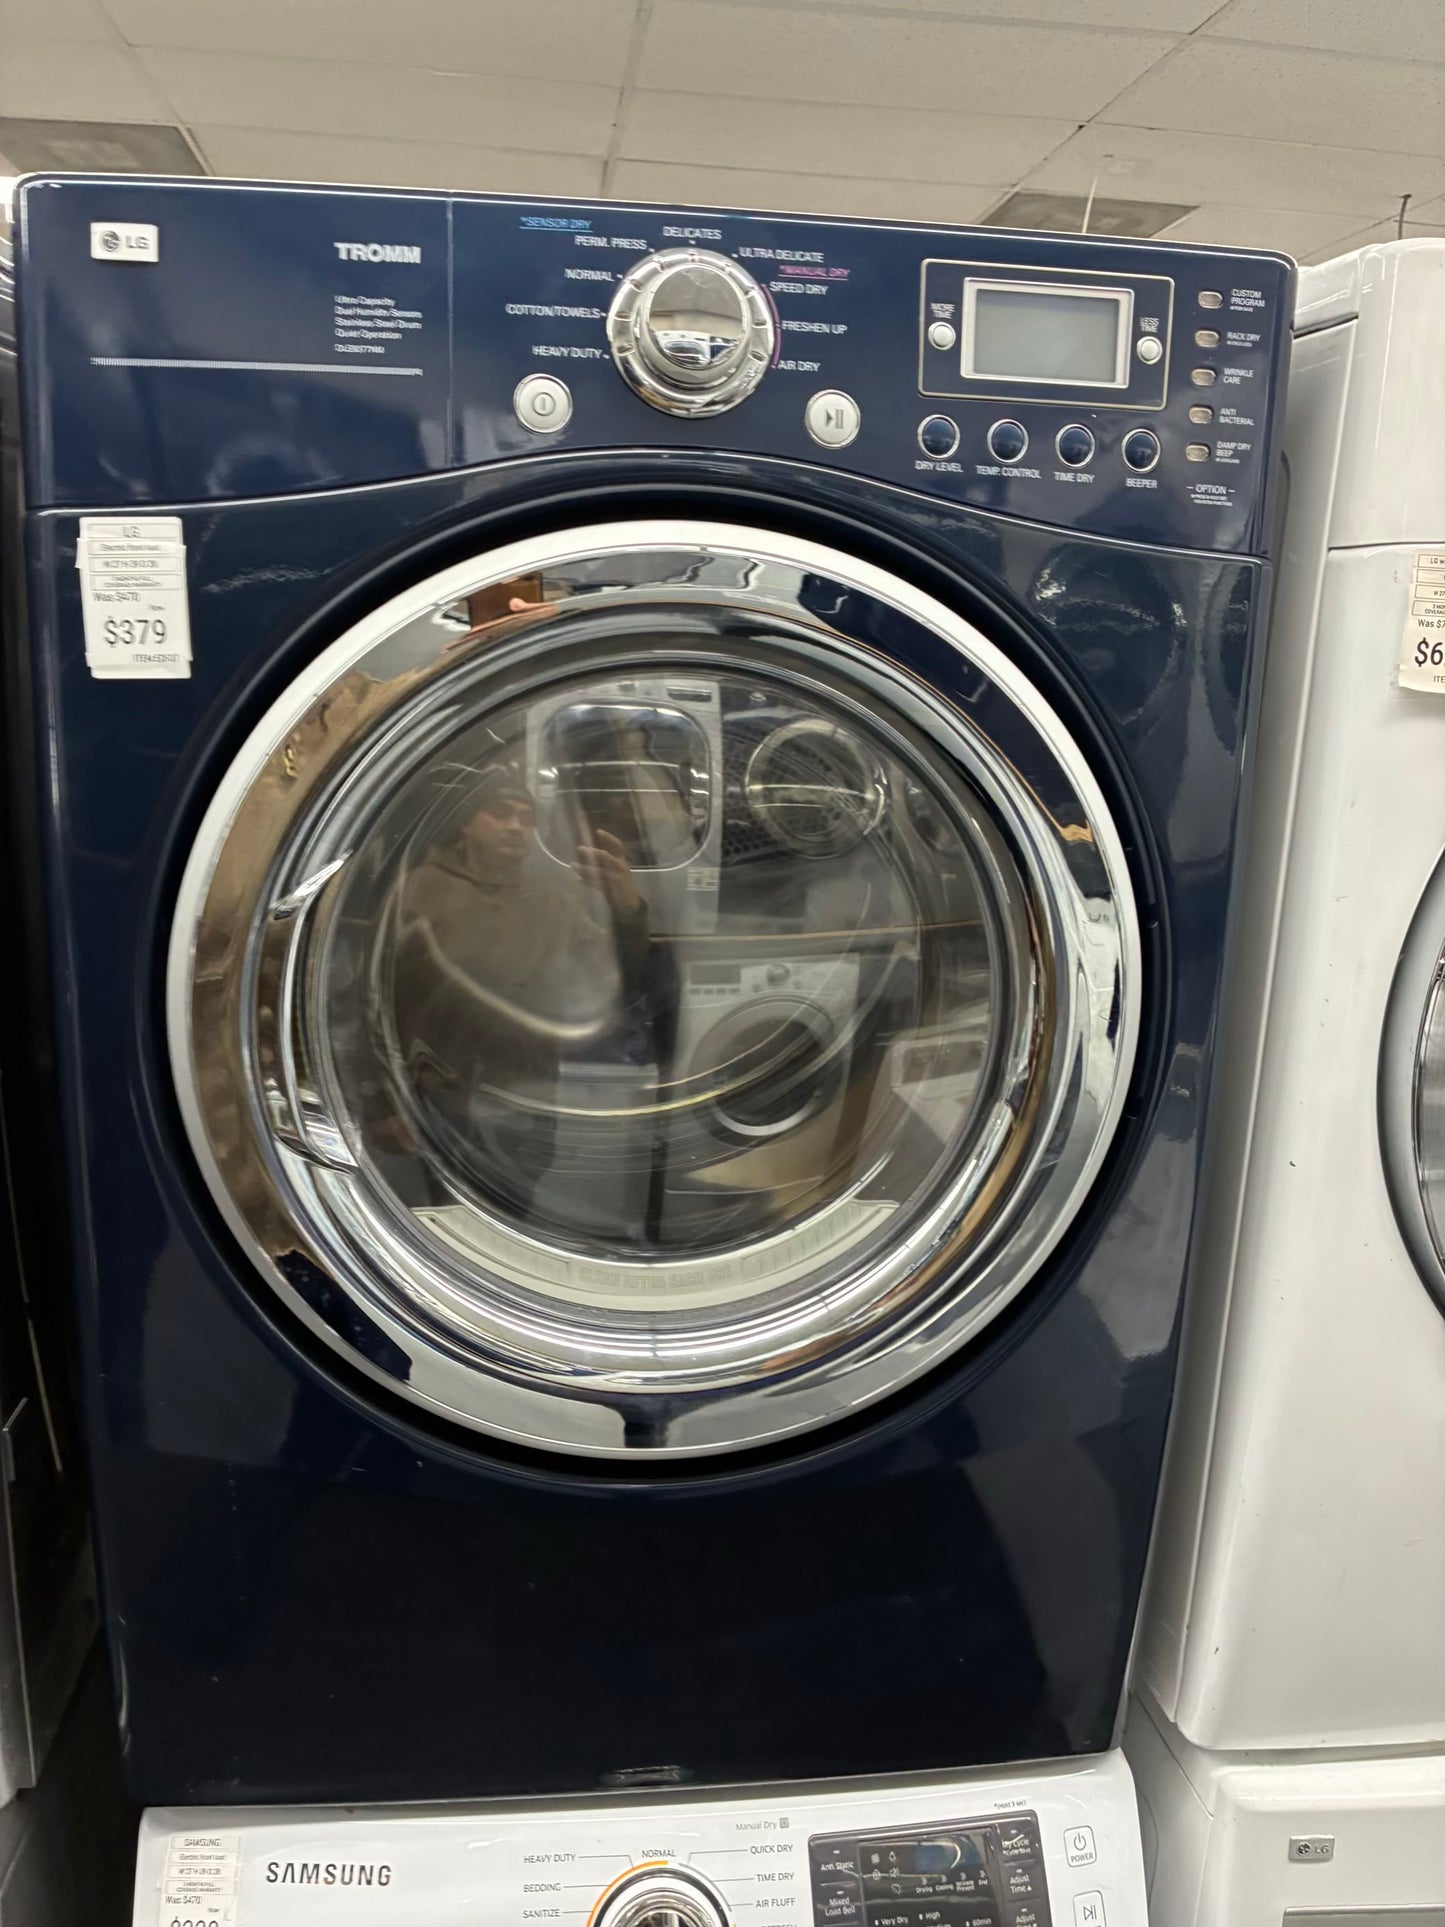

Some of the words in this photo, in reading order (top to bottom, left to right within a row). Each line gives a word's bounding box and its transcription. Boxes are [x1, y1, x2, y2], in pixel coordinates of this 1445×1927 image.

[569, 219, 592, 229] DRY
[663, 226, 721, 240] DELICATES
[125, 236, 149, 249] LG
[574, 235, 610, 247] PERM.
[611, 237, 647, 250] PRESS
[334, 243, 421, 264] TROMM
[739, 247, 774, 259] ULTRA
[775, 249, 824, 263] DELICATE
[565, 268, 615, 282] NORMAL
[828, 267, 850, 277] DRY
[769, 281, 804, 294] SPEED
[805, 284, 828, 295] DRY
[1231, 289, 1262, 299] CUSTOM
[1230, 297, 1266, 308] PROGRAM
[506, 303, 601, 319] COTTON/TOWELS
[781, 320, 830, 333] FRESHEN
[831, 324, 848, 334] UP
[1227, 332, 1245, 340] RACK
[1246, 333, 1261, 342] DRY
[532, 345, 569, 357] HEAVY
[569, 347, 602, 358] DUTY
[778, 360, 796, 370] AIR
[797, 361, 821, 372] DRY
[1224, 368, 1254, 378] WRINKLE
[1223, 376, 1241, 385] CARE
[1220, 408, 1237, 416] ANTI
[1219, 416, 1255, 426] BACTERIAL
[1217, 441, 1237, 450] DAMP
[1237, 442, 1252, 451] DRY
[1216, 449, 1234, 457] BEEP
[915, 460, 935, 471] DRY
[935, 462, 964, 473] LEVEL
[1002, 467, 1042, 479] CONTROL
[1054, 471, 1076, 482] TIME
[1077, 472, 1095, 484] DRY
[1125, 478, 1158, 489] BEEPER
[1195, 484, 1227, 494] OPTION
[1430, 557, 1439, 565] LG
[1417, 618, 1434, 628] Was
[104, 615, 167, 648] $379
[1414, 637, 1445, 668] $6
[764, 1820, 777, 1830] Dry
[641, 1849, 676, 1859] NORMAL
[750, 1845, 775, 1855] QUICK
[776, 1844, 794, 1853] DRY
[1314, 1844, 1329, 1854] LG
[523, 1855, 552, 1864] HEAVY
[553, 1853, 576, 1863] DUTY
[1070, 1852, 1094, 1863] POWER
[266, 1861, 392, 1886] SAMSUNG
[756, 1873, 777, 1882] TIME
[778, 1872, 795, 1881] DRY
[523, 1884, 561, 1893] BEDDING
[1010, 1885, 1026, 1893] Time
[756, 1900, 770, 1908] AIR
[772, 1898, 796, 1907] FLUFF
[523, 1909, 561, 1919] SANITIZE
[925, 1911, 941, 1920] High
[897, 1916, 909, 1924] Dry
